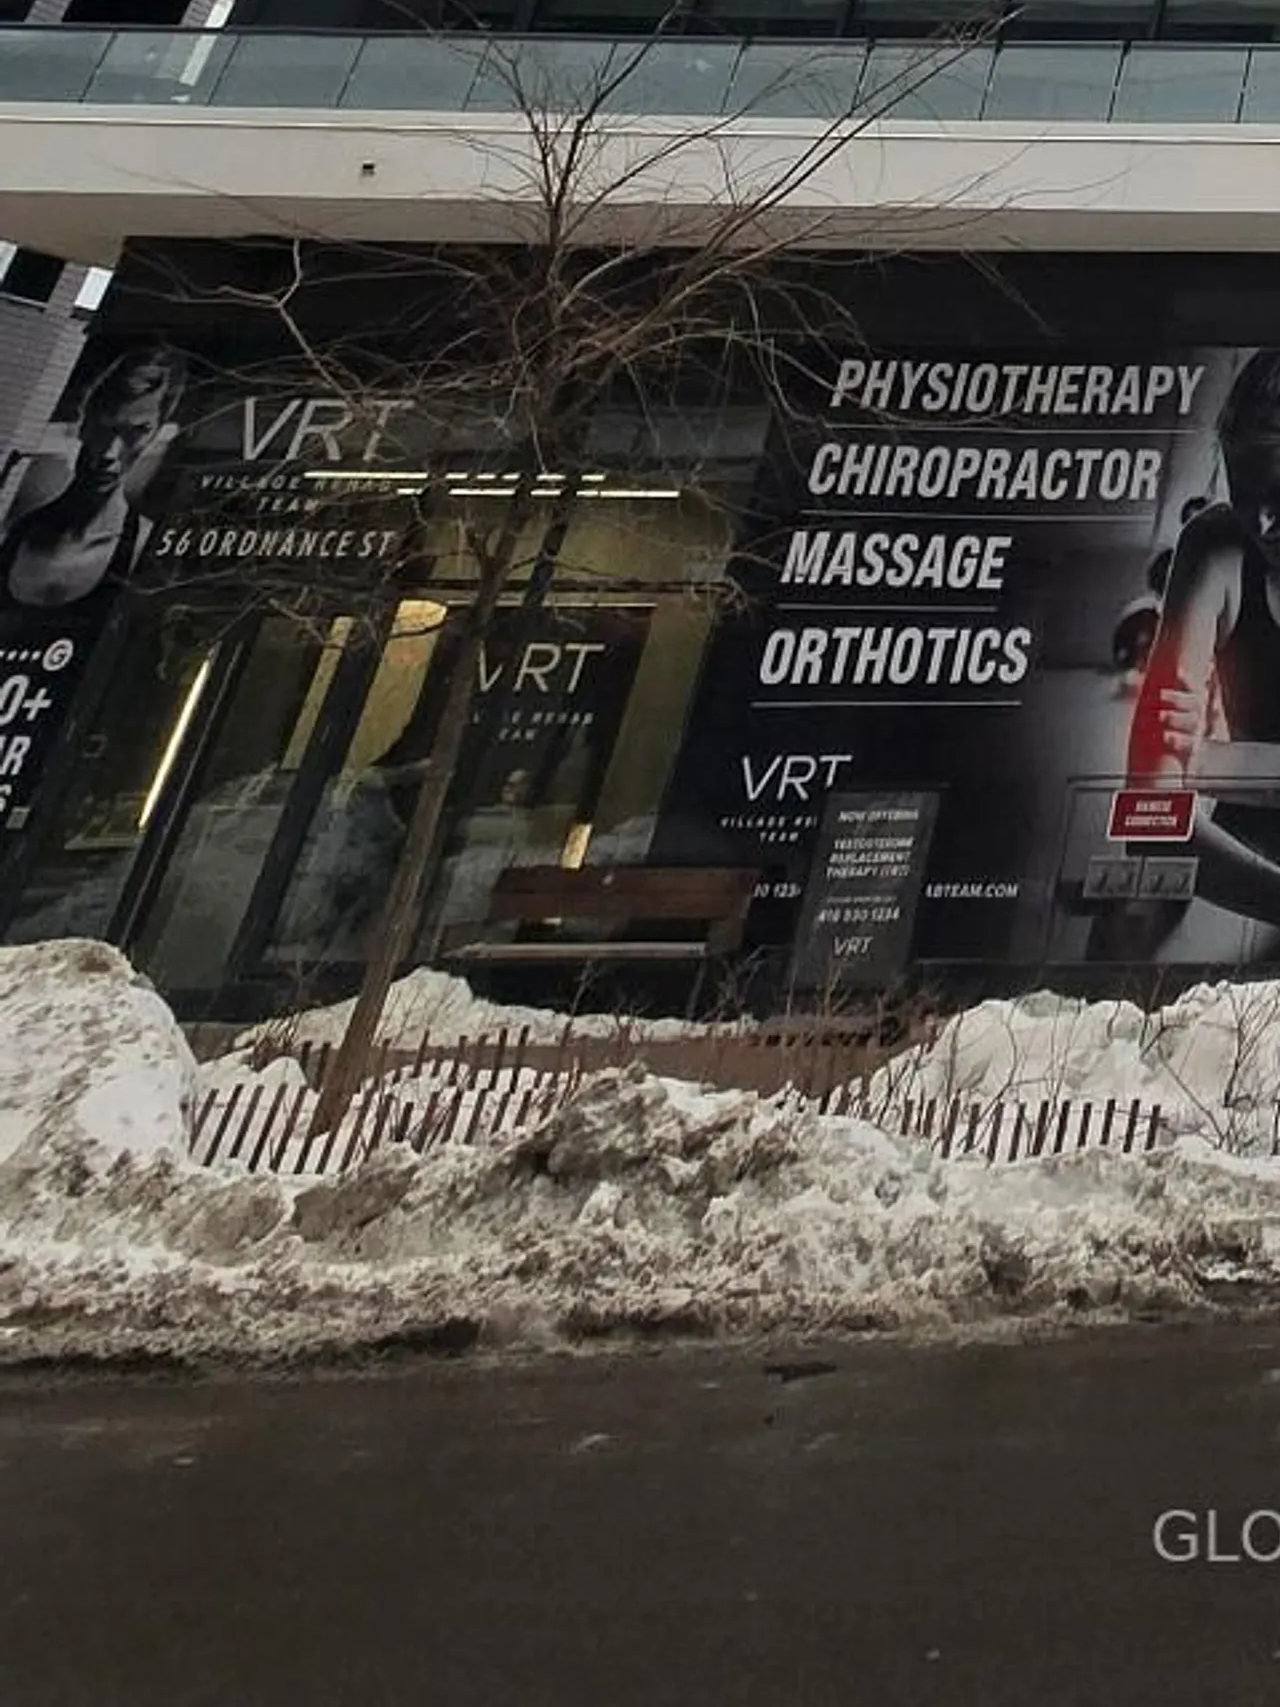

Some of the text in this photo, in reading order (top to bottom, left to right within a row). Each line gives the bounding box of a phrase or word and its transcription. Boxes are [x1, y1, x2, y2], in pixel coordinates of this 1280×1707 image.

[831, 359, 1206, 415] PHYSIOTHERAPY
[243, 396, 416, 462] VRT
[807, 443, 1164, 501] CHIROPRACTOR
[155, 528, 397, 558] 56 ORDNANCE ST
[780, 530, 1013, 589] MASSAGE
[477, 640, 605, 693] VRT
[759, 626, 1033, 686] ORTHOTICS
[742, 754, 853, 802] VRT
[833, 935, 874, 956] VRT
